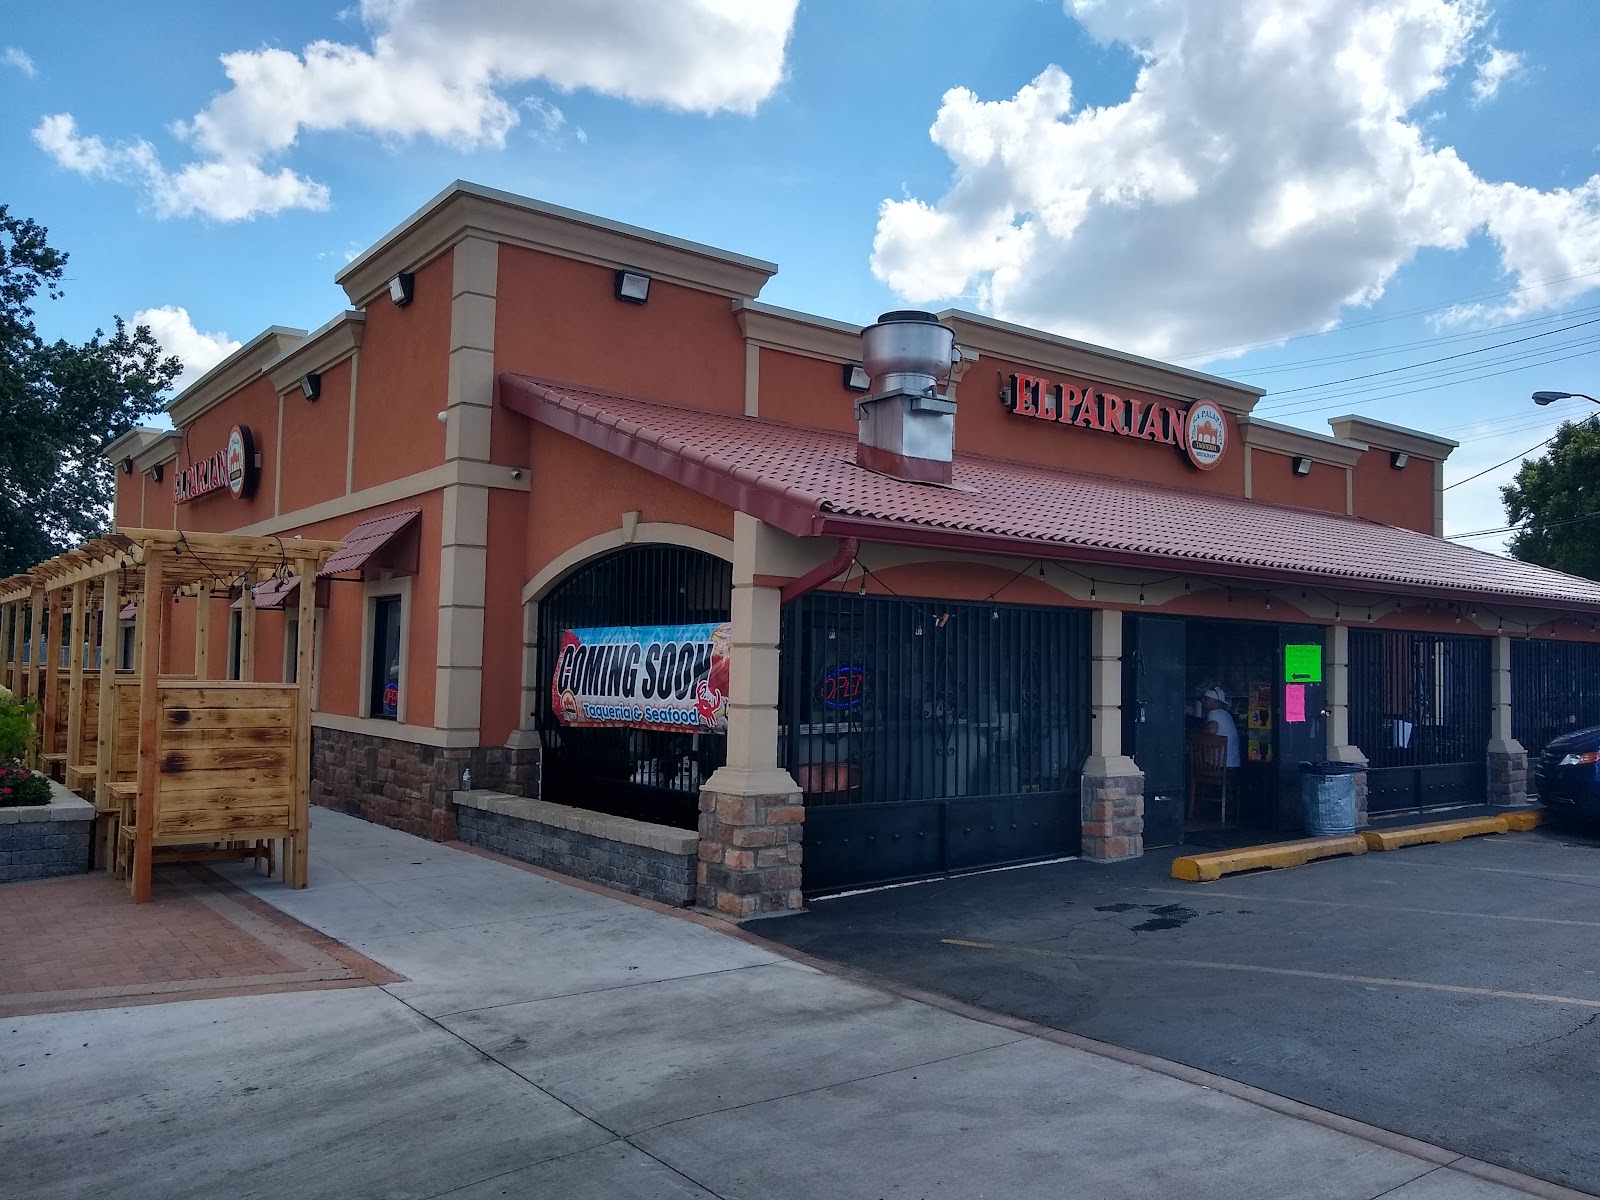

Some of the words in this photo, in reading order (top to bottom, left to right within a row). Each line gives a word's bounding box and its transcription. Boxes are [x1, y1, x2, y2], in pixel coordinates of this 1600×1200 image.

[1013, 373, 1056, 420] EL
[1058, 382, 1186, 450] PARIAN
[173, 470, 186, 505] EL
[186, 448, 229, 499] PARIAN
[558, 643, 640, 699] COMING
[642, 642, 714, 700] SOON
[583, 702, 631, 721] Taqueria
[634, 708, 643, 720] &
[645, 706, 699, 725] Seafood
